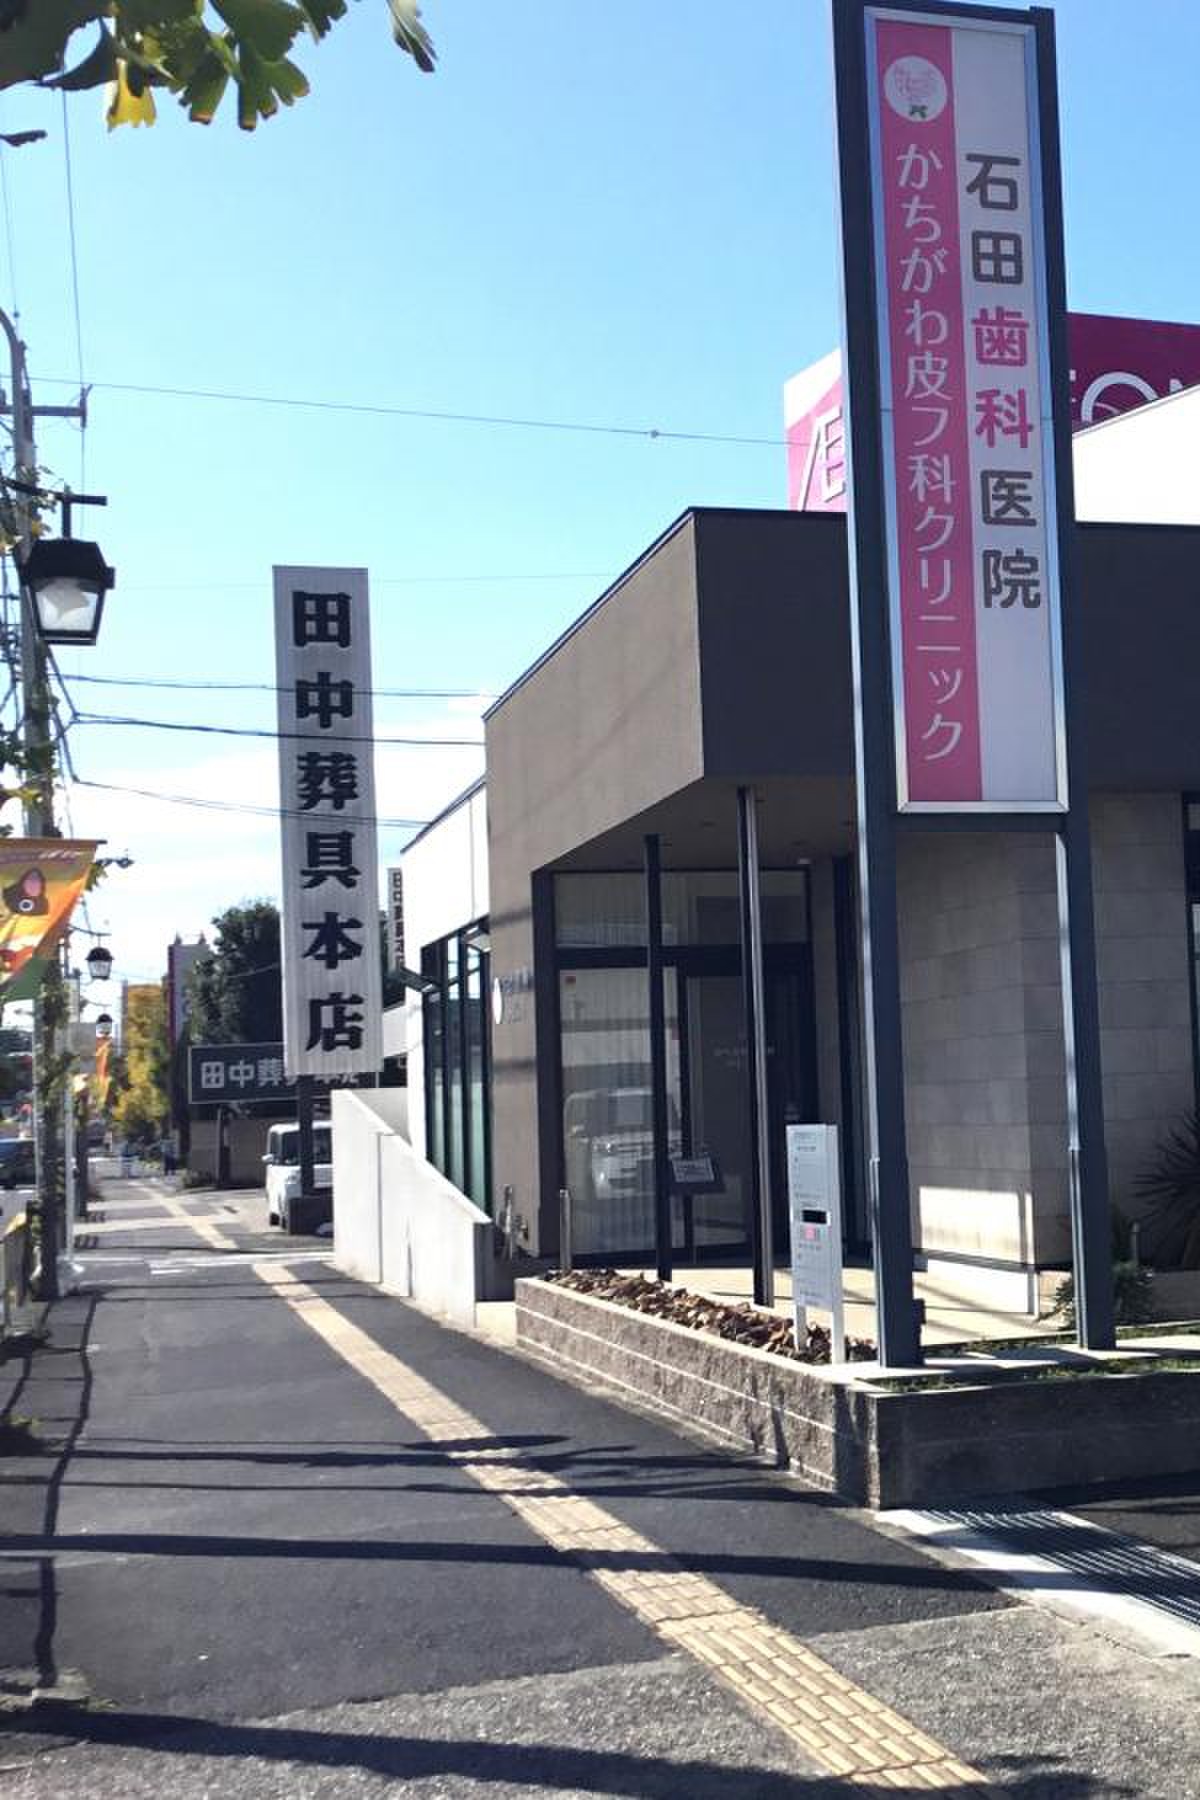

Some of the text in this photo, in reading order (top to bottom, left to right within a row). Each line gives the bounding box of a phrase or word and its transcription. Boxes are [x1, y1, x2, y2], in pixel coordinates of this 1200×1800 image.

[896, 143, 963, 762] かちがわ皮フ科クリニック
[965, 152, 1041, 609] 石田歯科医院
[294, 590, 366, 1053] 田中葬具本店
[200, 1057, 359, 1089] 田中葬
